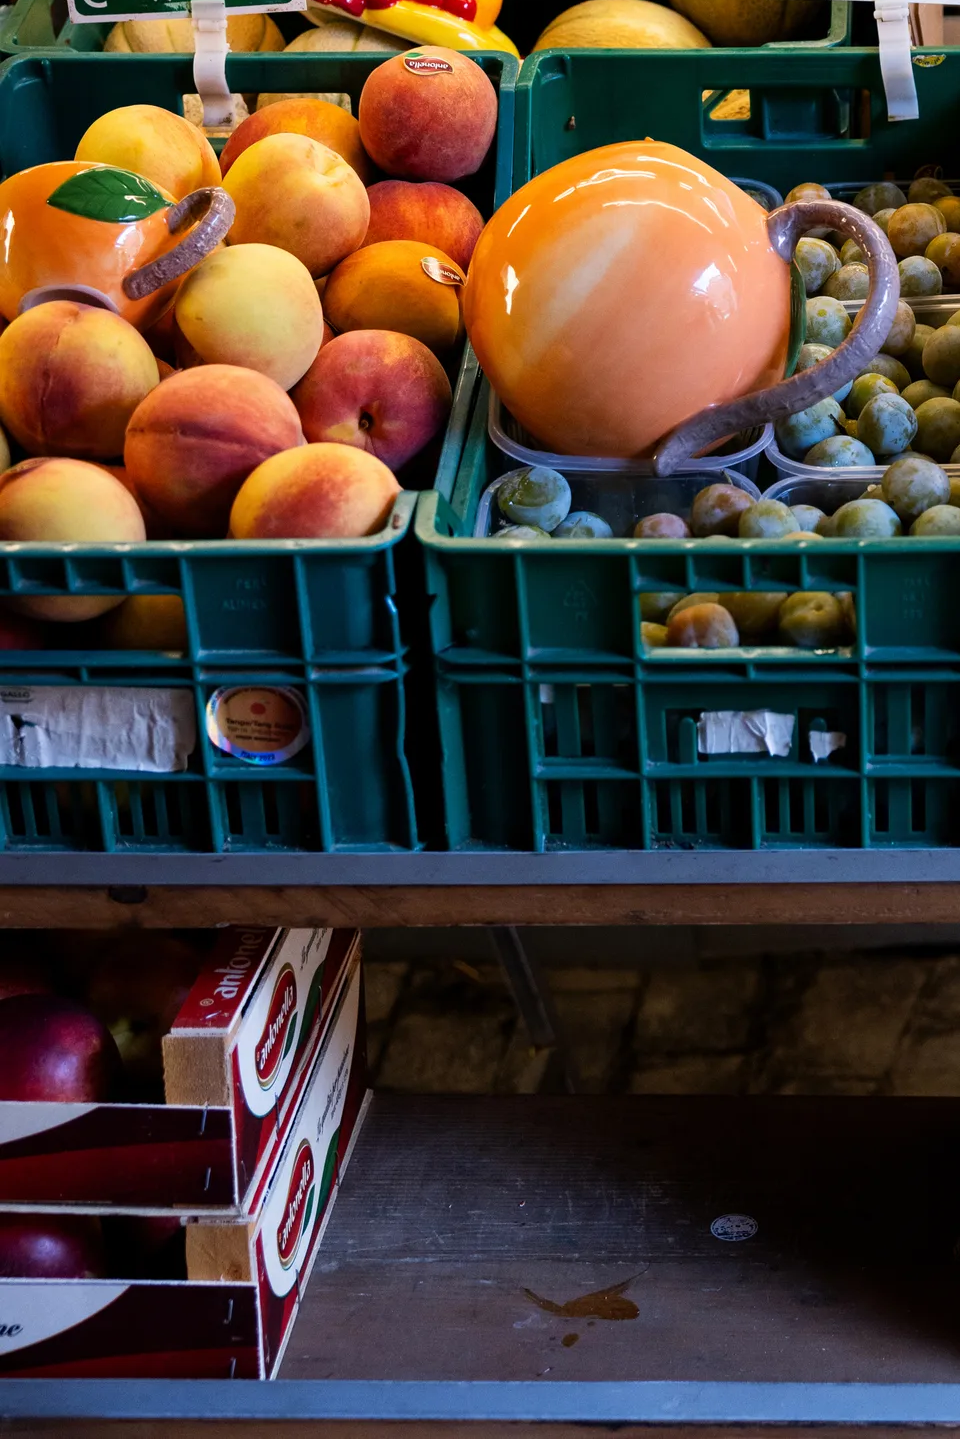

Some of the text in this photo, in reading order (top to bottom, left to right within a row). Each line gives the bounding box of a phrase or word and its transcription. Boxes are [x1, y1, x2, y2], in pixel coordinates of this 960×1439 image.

[409, 61, 449, 69] antonella
[258, 985, 294, 1071] antonella
[281, 1158, 311, 1250] antonella
